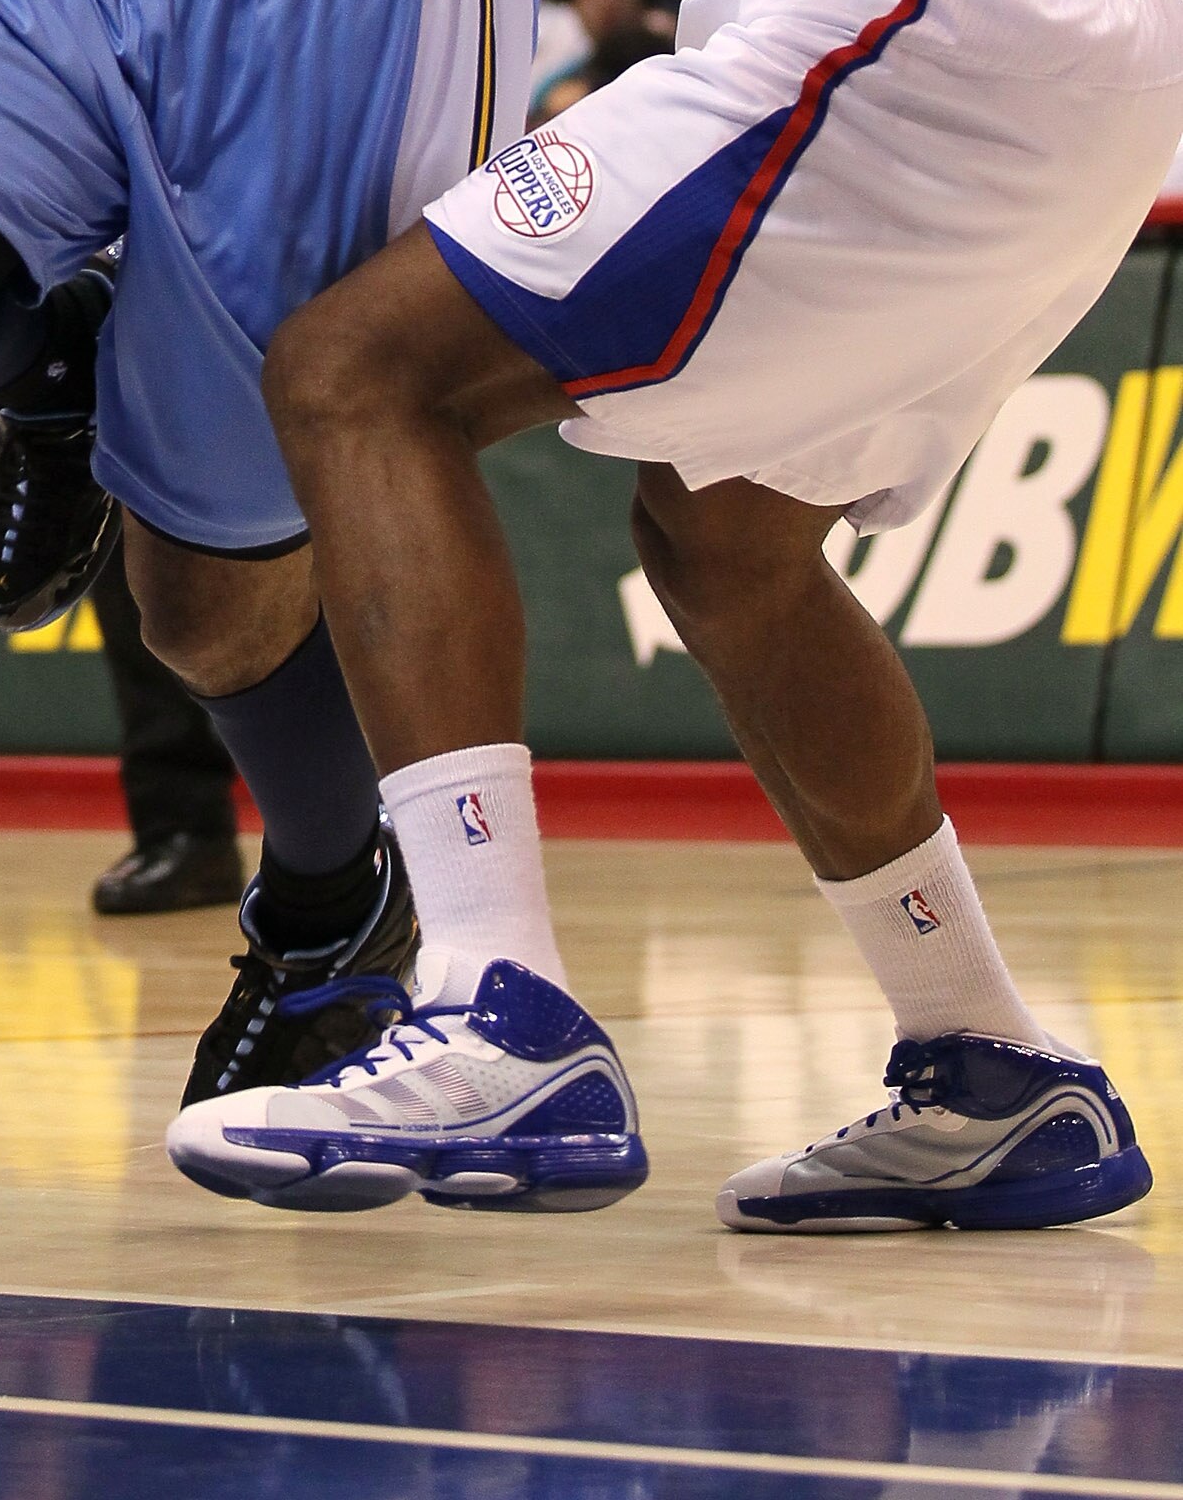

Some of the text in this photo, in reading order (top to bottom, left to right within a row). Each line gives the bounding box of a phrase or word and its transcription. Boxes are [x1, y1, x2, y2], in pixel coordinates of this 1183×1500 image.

[485, 138, 562, 228] CLIPPERS
[530, 153, 575, 216] LOS ANGELES
